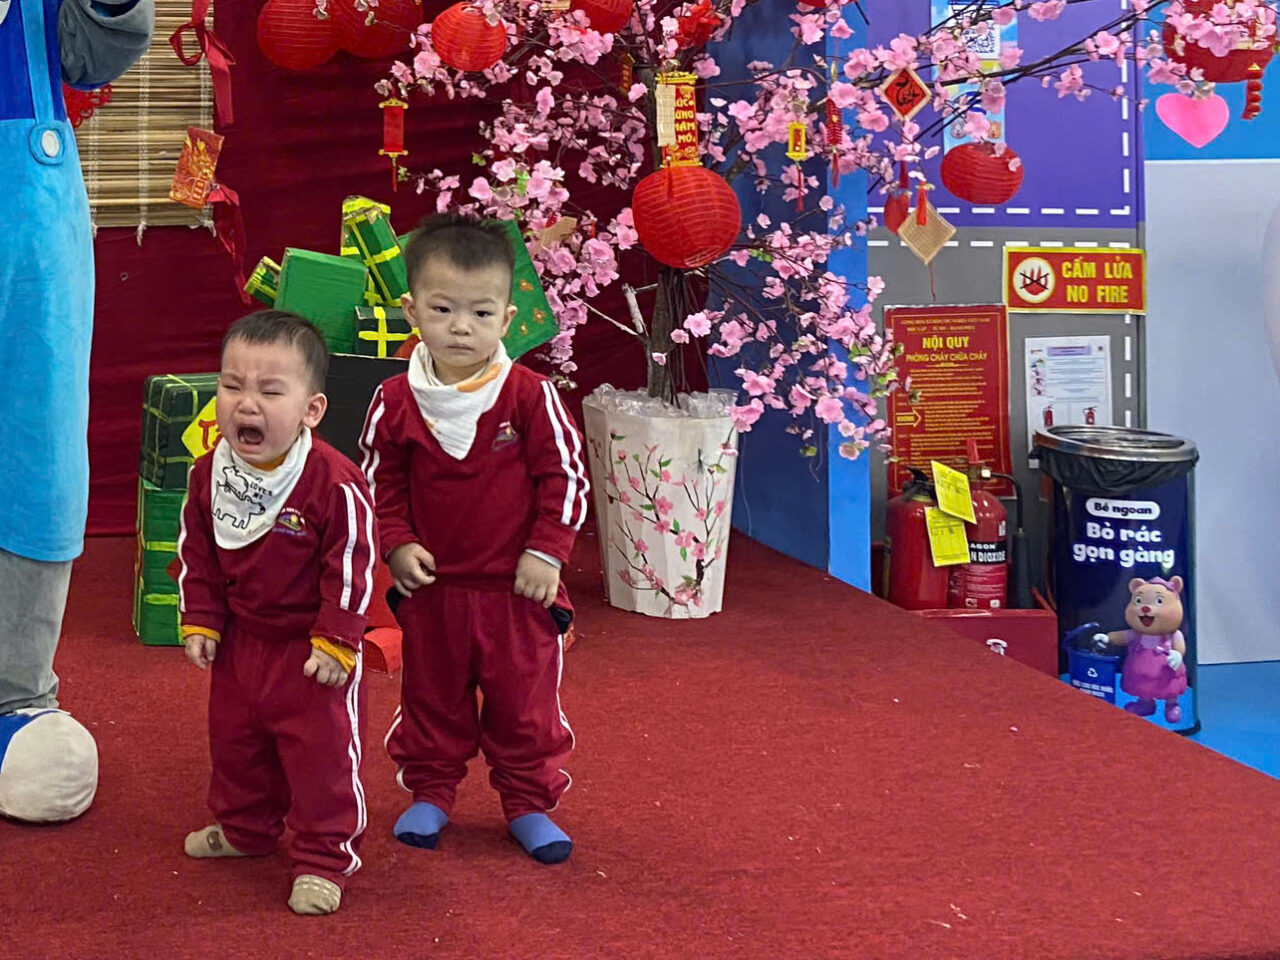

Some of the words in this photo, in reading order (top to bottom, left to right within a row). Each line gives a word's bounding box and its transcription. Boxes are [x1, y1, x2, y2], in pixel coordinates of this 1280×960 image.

[1061, 256, 1097, 279] CẤM
[1104, 256, 1134, 279] LỬA
[1066, 284, 1089, 303] NO
[1097, 285, 1129, 303] FIRE
[922, 335, 944, 351] NỘI
[946, 336, 970, 350] QUY
[1112, 505, 1153, 517] ngoan
[1120, 525, 1162, 542] rác
[1073, 543, 1115, 563] gọn
[1119, 546, 1175, 569] gàng
